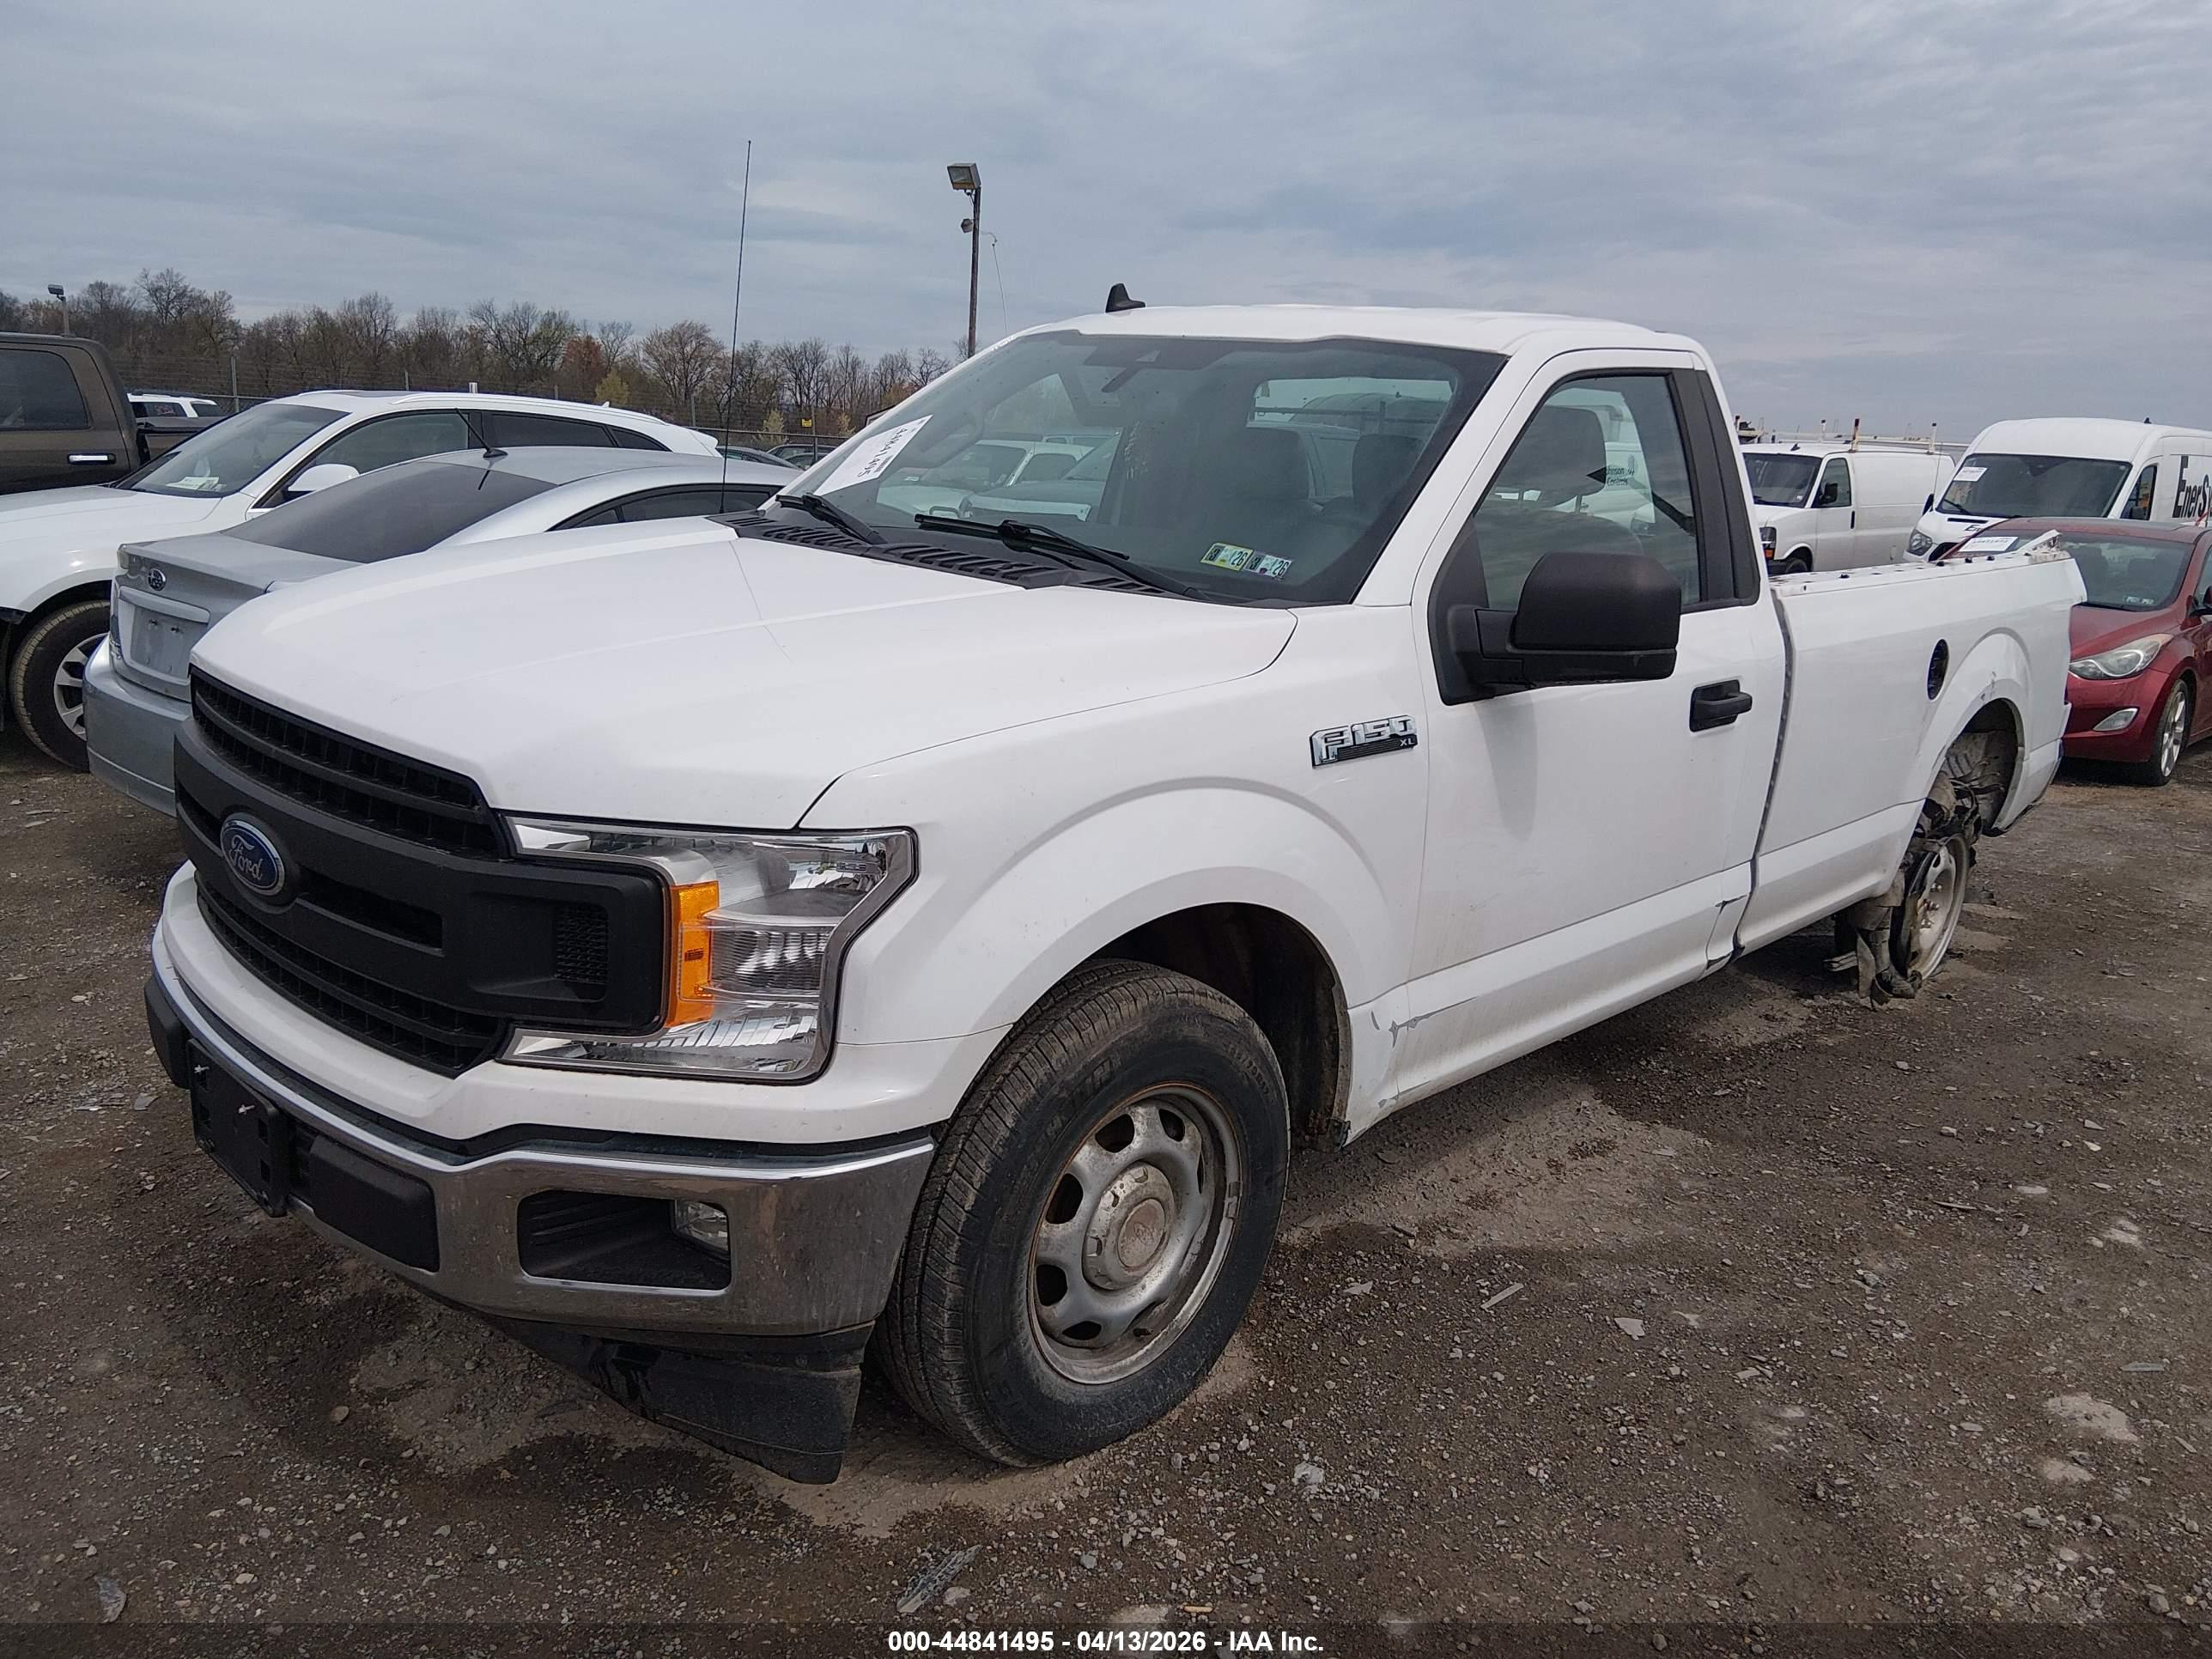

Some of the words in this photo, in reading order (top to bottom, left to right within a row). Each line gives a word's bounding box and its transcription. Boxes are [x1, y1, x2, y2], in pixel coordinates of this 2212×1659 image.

[1231, 550, 1249, 567] 26
[1400, 738, 1415, 747] XL
[229, 835, 264, 881] Ford
